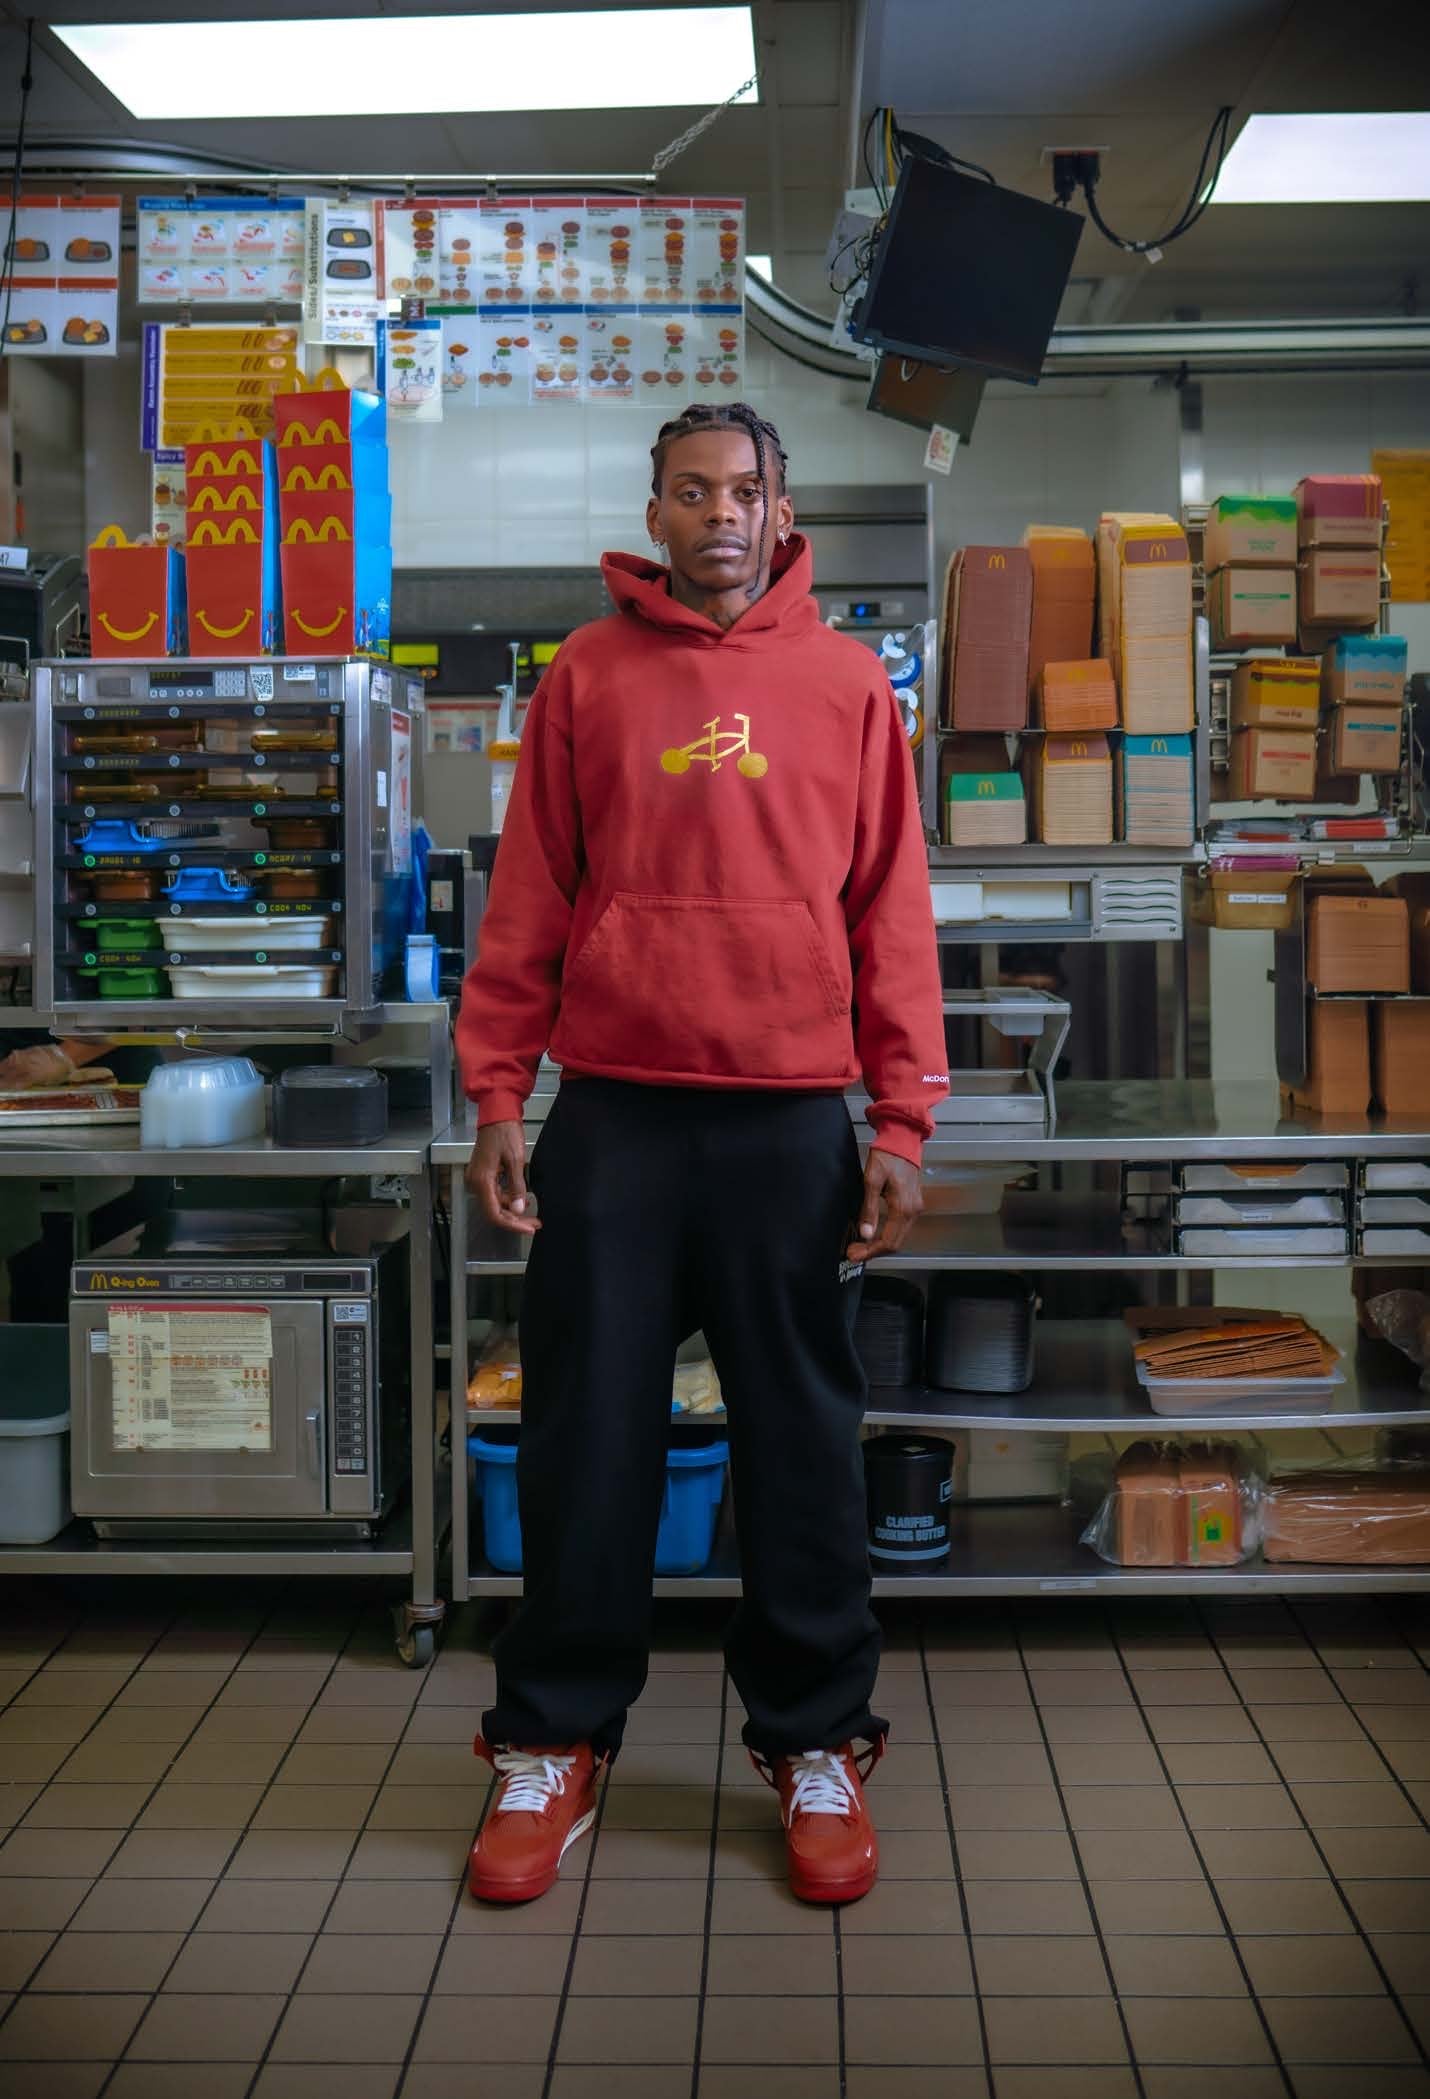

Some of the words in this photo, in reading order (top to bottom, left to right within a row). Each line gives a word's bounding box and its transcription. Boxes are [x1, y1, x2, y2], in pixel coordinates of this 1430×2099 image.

[309, 213, 320, 285] Substitutions
[136, 1277, 160, 1288] Oven
[885, 1515, 935, 1528] CLARIFIED
[915, 1524, 946, 1541] BUTTER
